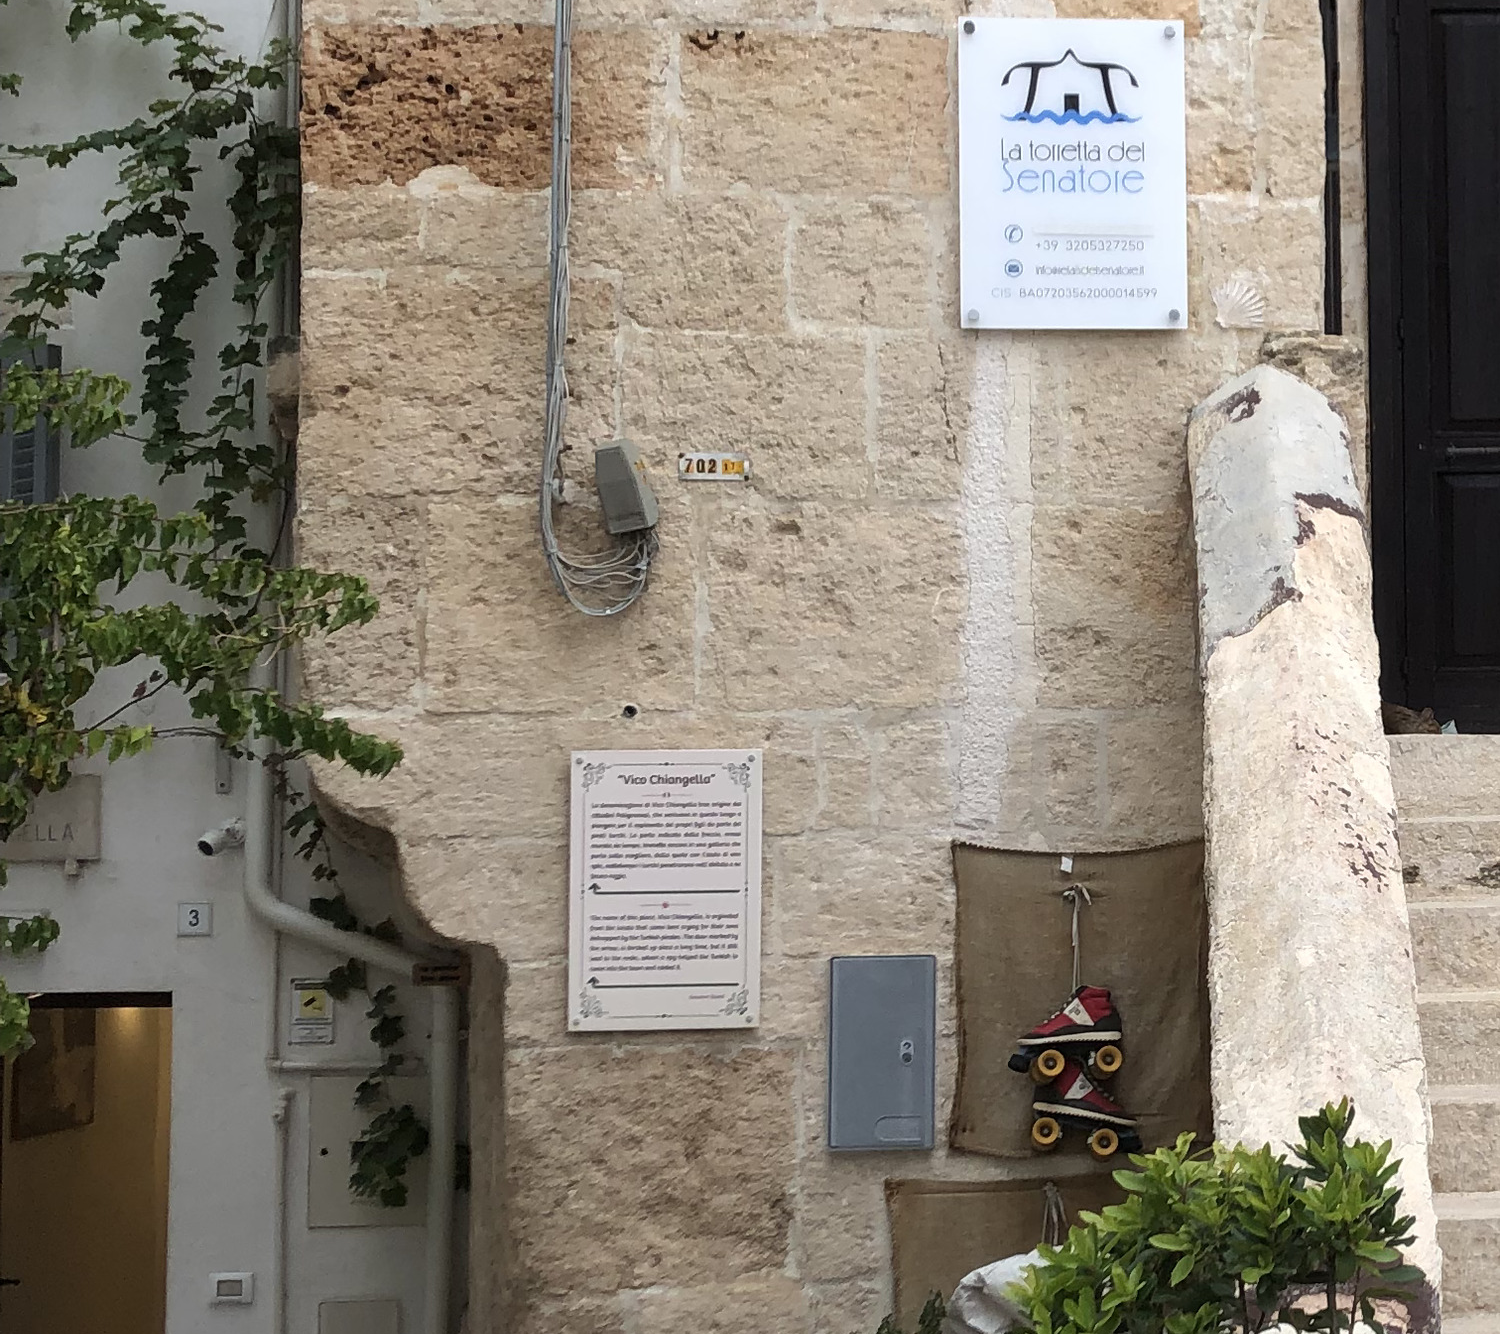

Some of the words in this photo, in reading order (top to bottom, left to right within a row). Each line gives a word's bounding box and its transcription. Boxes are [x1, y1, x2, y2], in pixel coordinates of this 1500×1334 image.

[1000, 137, 1022, 161] La
[1029, 140, 1101, 162] torretta
[1107, 141, 1145, 162] del
[1002, 158, 1145, 193] Senatore
[1035, 240, 1059, 252] +39
[684, 457, 717, 474] 702
[17, 822, 75, 842] ELLA
[188, 909, 200, 927] 3
